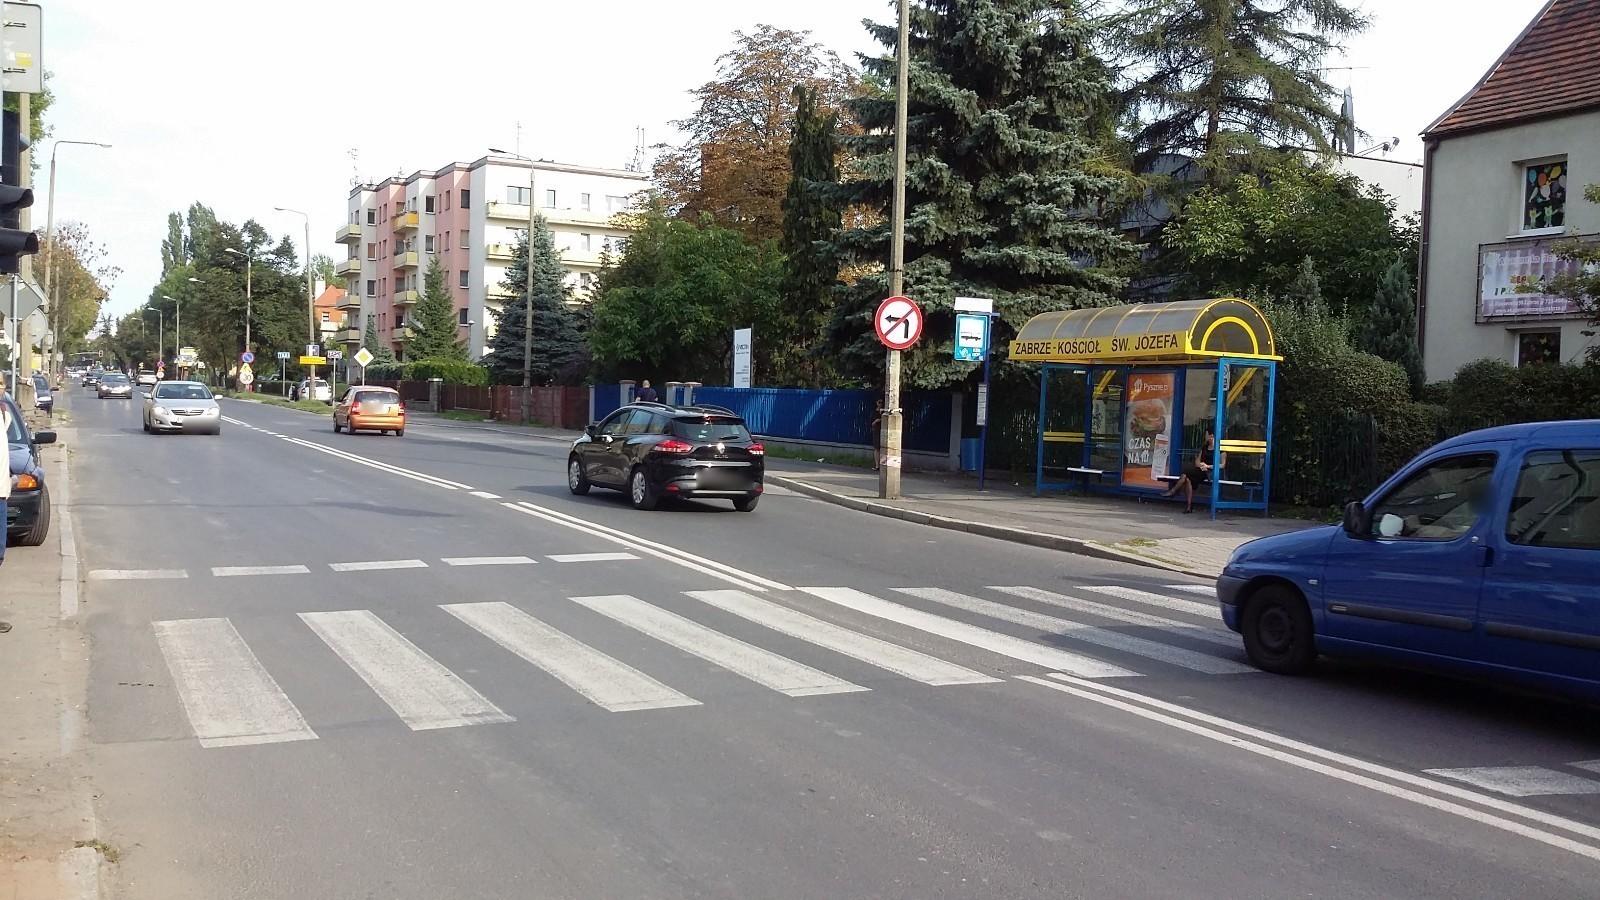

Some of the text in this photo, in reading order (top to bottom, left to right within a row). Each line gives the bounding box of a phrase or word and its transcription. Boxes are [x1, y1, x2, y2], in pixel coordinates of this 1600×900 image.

[1111, 336, 1131, 352] ŚW.
[1128, 437, 1151, 450] CZAS
[1127, 452, 1140, 464] NA
